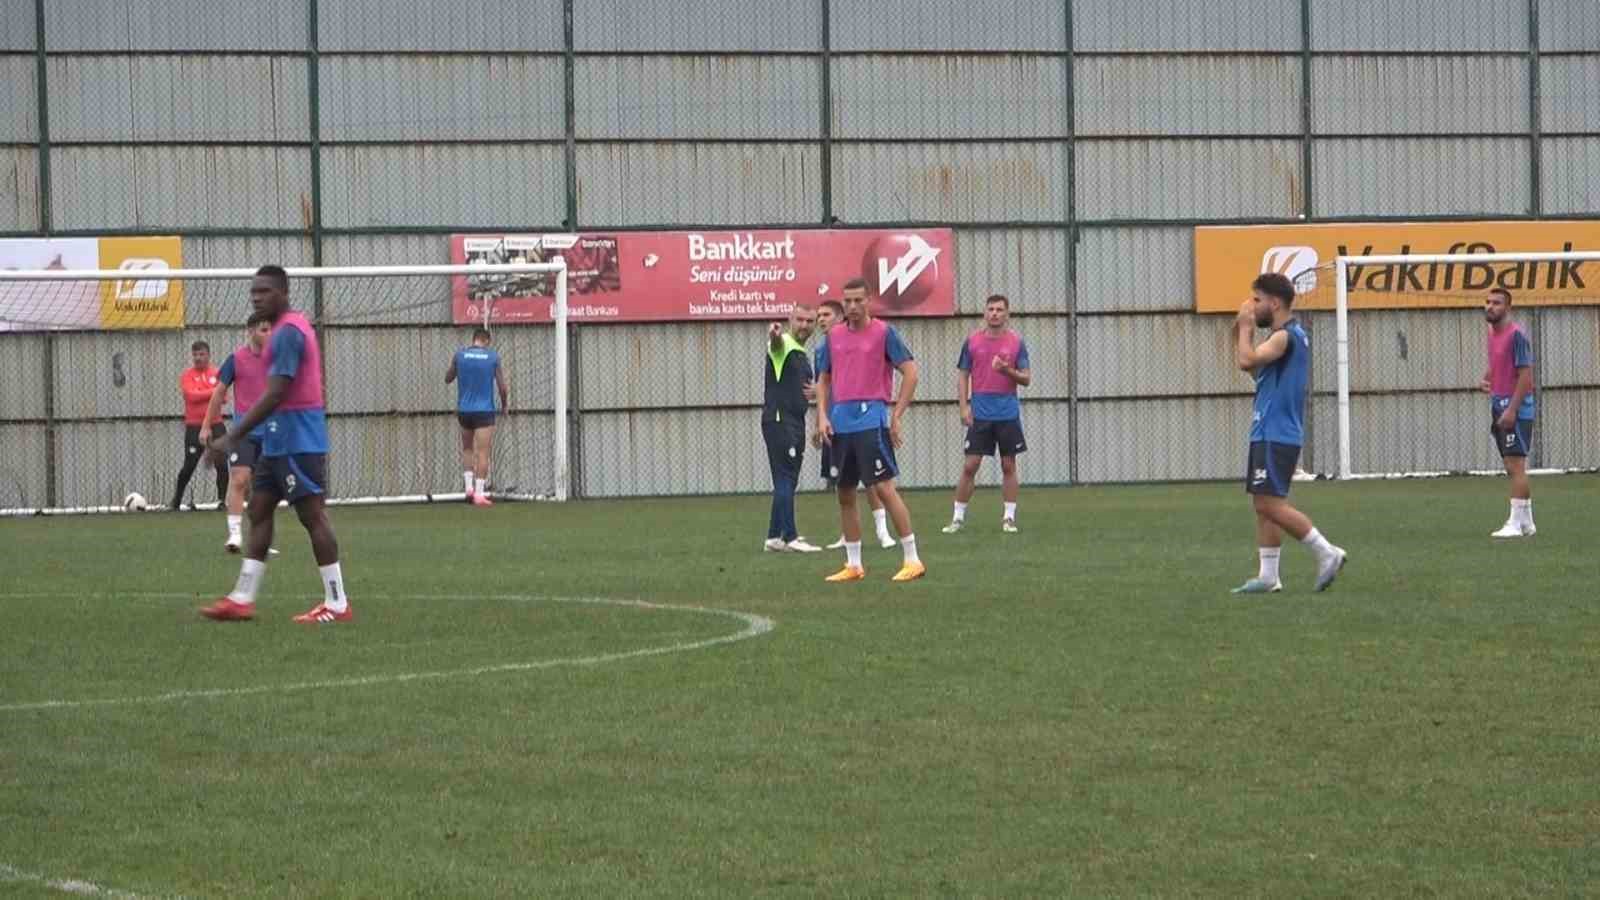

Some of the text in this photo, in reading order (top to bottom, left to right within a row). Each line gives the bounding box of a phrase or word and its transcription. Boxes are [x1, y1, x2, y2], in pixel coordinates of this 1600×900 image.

[688, 232, 795, 260] Bankkart
[690, 265, 796, 286] Seni düşünür o
[710, 289, 776, 301] Kredi kartı ve
[689, 302, 720, 314] banka
[722, 302, 745, 313] kartı
[747, 302, 763, 313] tek
